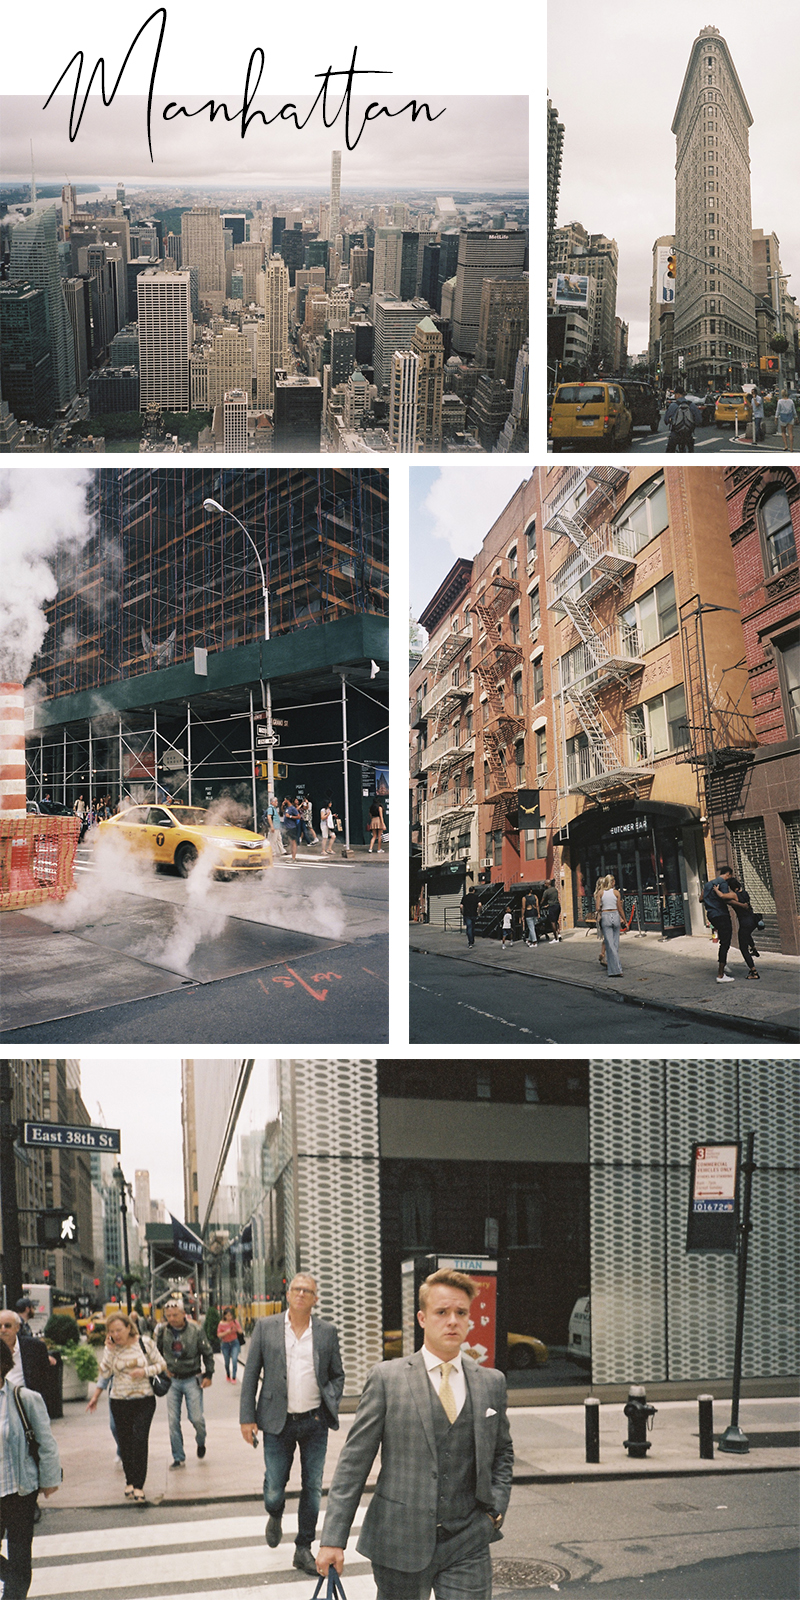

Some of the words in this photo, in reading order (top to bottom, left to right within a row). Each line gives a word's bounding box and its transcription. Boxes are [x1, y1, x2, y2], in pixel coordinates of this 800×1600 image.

[610, 822, 635, 835] BUTCHER
[635, 820, 647, 830] BAR
[31, 1128, 63, 1143] East
[65, 1131, 96, 1146] 38th
[98, 1134, 113, 1147] St
[454, 1260, 483, 1269] TITAN
